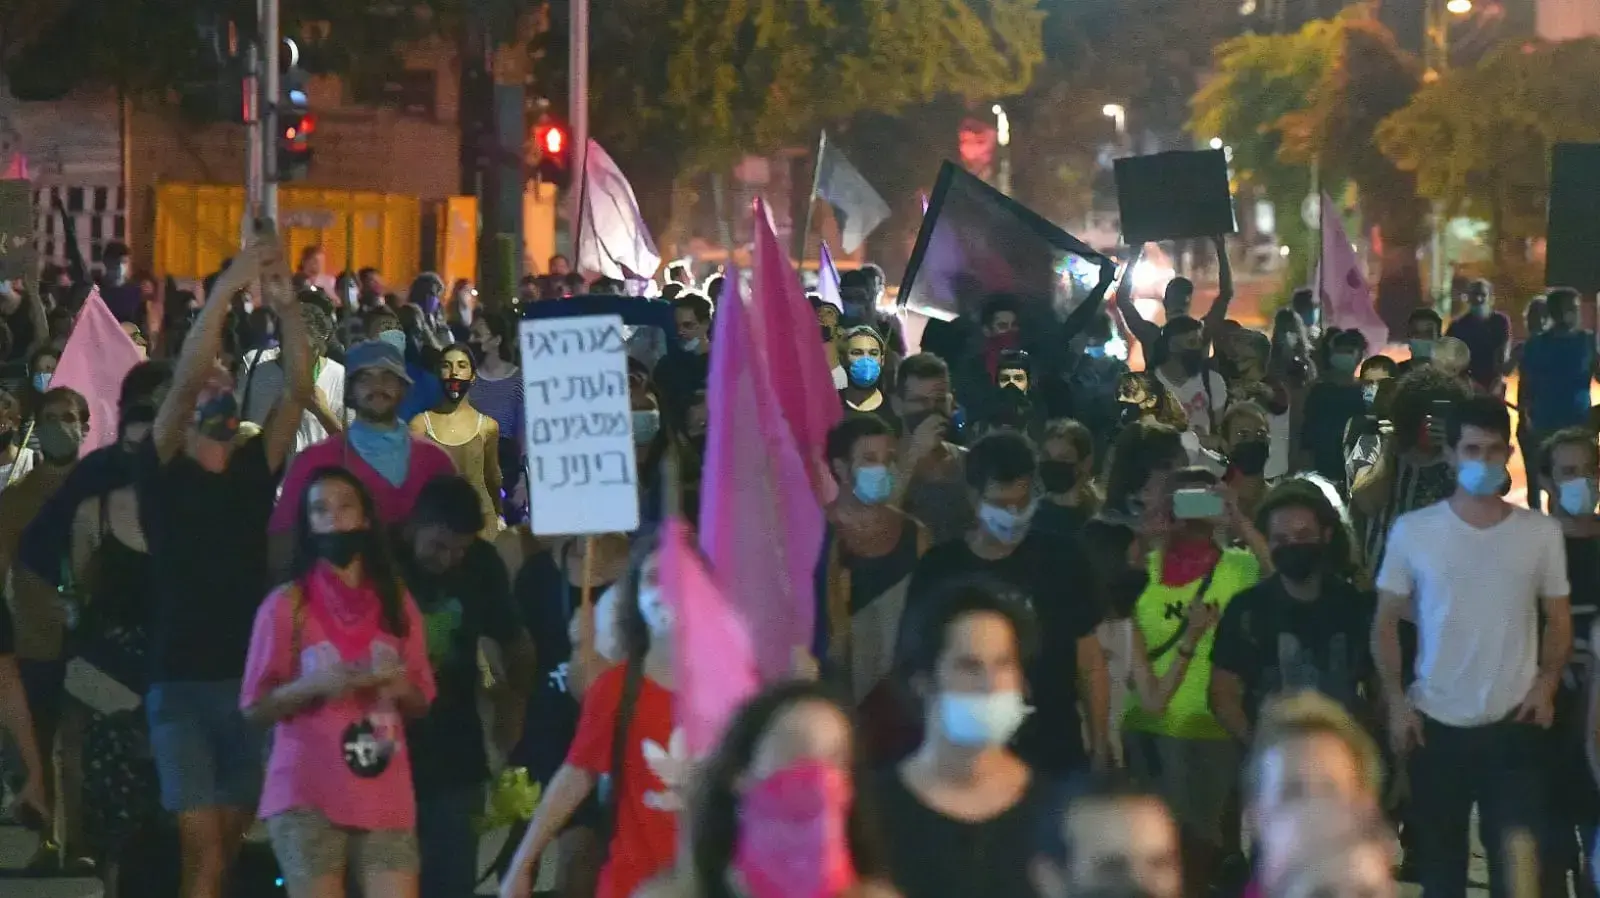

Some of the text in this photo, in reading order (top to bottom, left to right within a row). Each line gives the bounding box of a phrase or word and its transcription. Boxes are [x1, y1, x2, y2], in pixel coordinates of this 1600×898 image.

[526, 325, 624, 360] מנהיגי
[528, 369, 625, 405] העתיד
[532, 410, 628, 445] מפגינים
